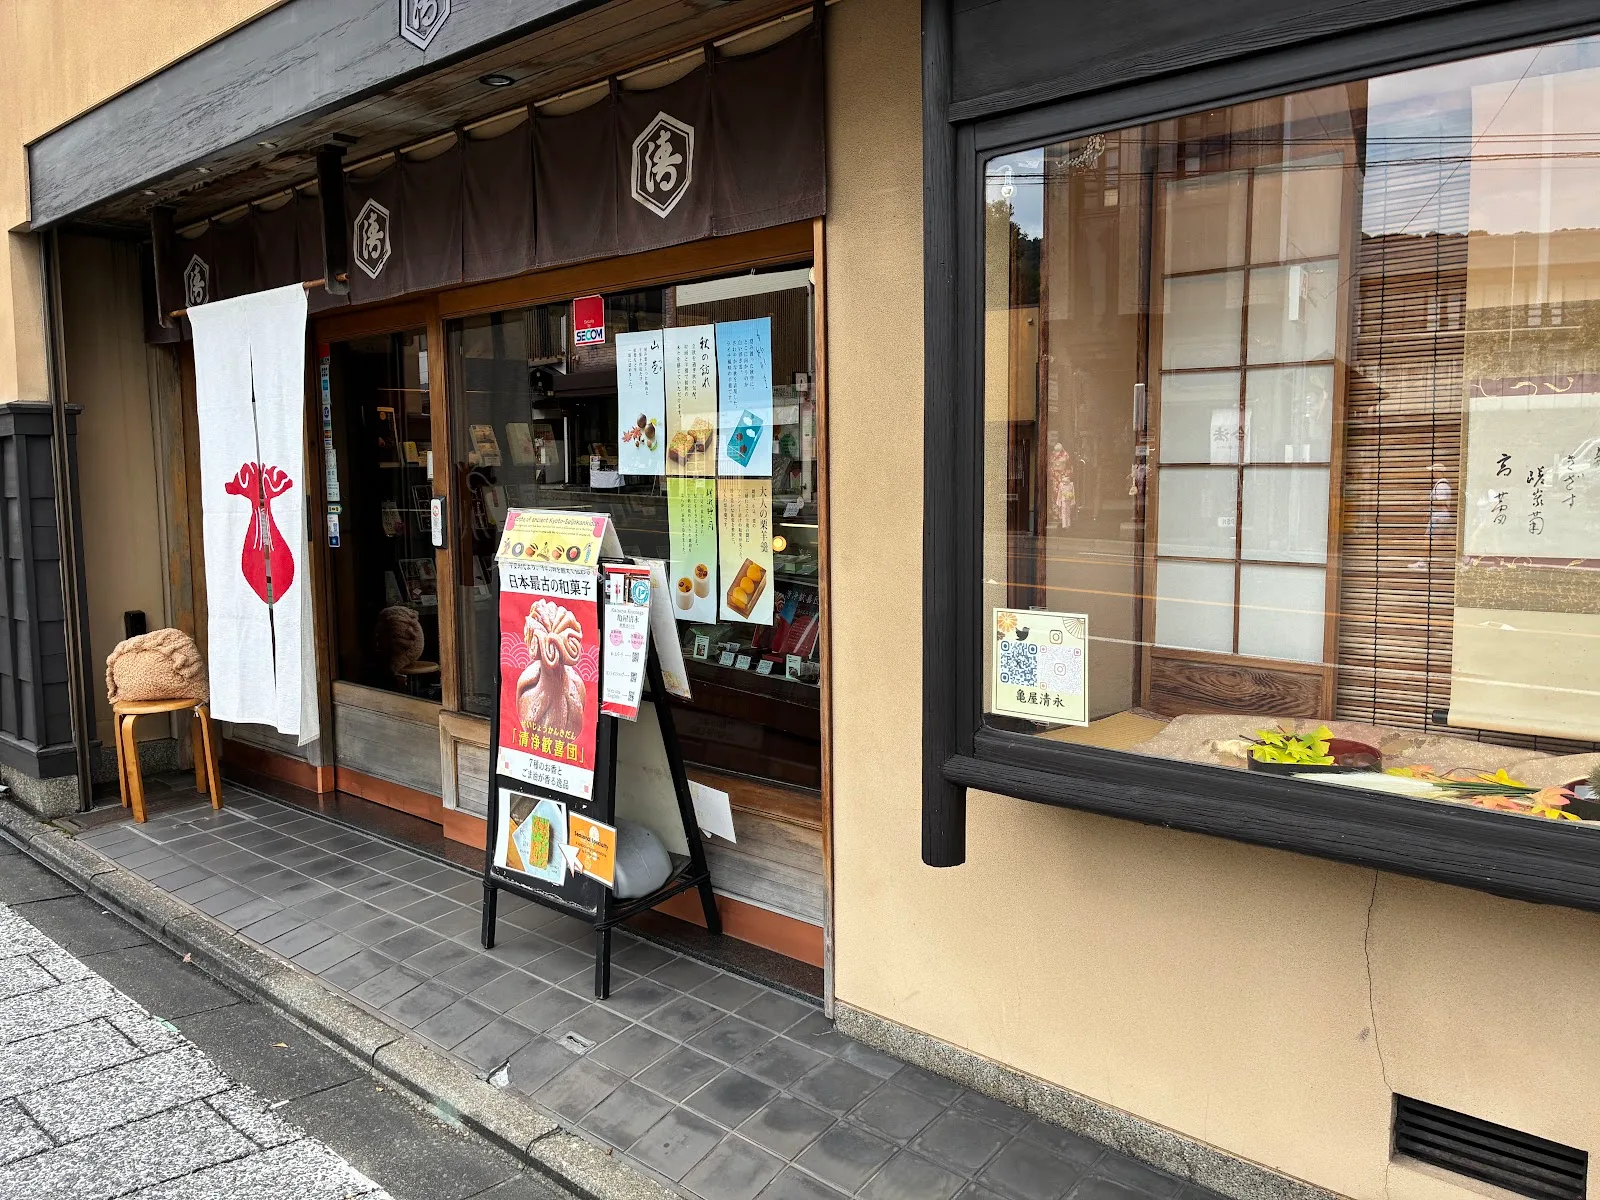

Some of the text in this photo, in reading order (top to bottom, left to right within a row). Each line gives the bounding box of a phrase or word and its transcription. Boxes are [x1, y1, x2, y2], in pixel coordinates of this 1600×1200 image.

[576, 328, 604, 342] SECOM
[699, 336, 711, 388] 秋の訪れ
[759, 485, 768, 553] 大人の栗羊羹
[508, 573, 591, 596] 日本最古の和菓子
[1016, 688, 1066, 708] 亀屋清永
[520, 719, 577, 741] せいじょうかんきだん
[529, 758, 563, 776] 7種のお香と
